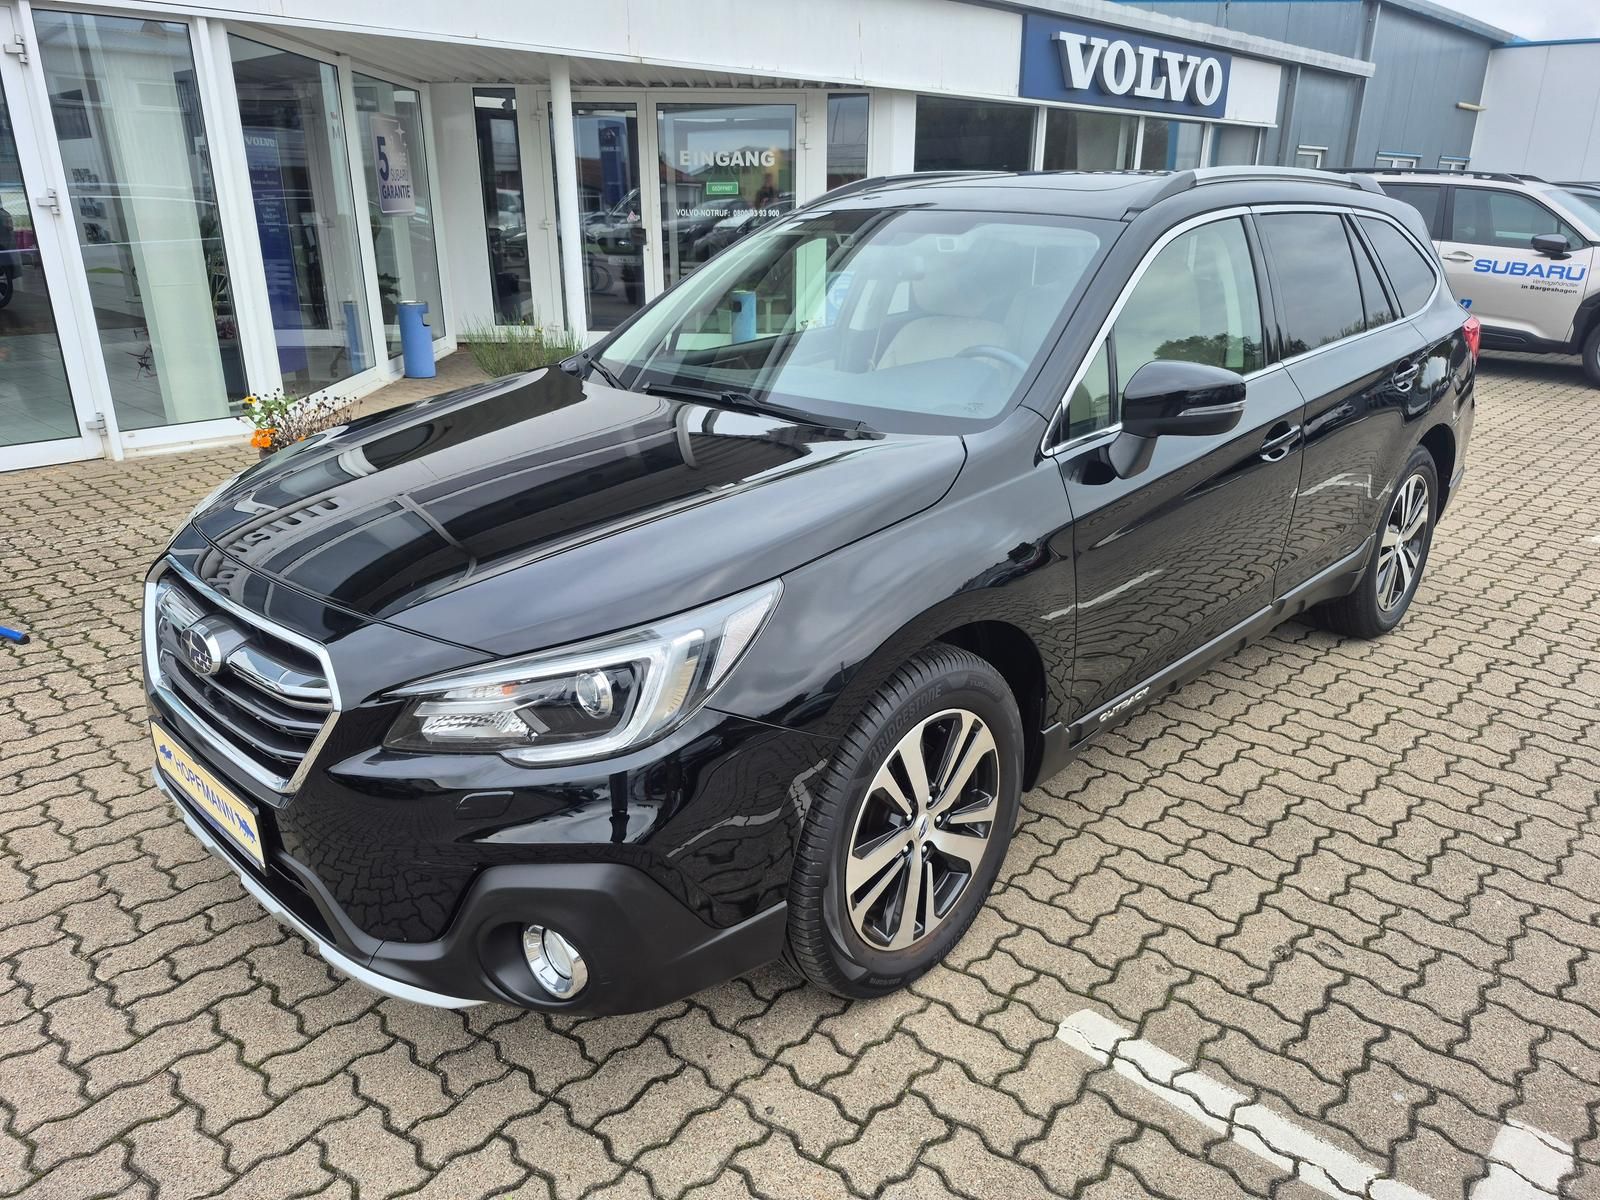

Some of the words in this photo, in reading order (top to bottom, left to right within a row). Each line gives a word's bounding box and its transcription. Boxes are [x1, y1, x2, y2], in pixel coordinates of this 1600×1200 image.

[1051, 31, 1223, 106] VOLVO
[245, 136, 276, 147] VOLVO
[376, 135, 390, 182] 5
[679, 150, 776, 167] EINGANG
[382, 184, 411, 199] GARANTIE
[675, 208, 731, 217] VOLVO-NOTRUF:
[768, 209, 780, 217] 900
[1473, 259, 1586, 281] SUBARU
[1099, 686, 1150, 722] OUTBACK
